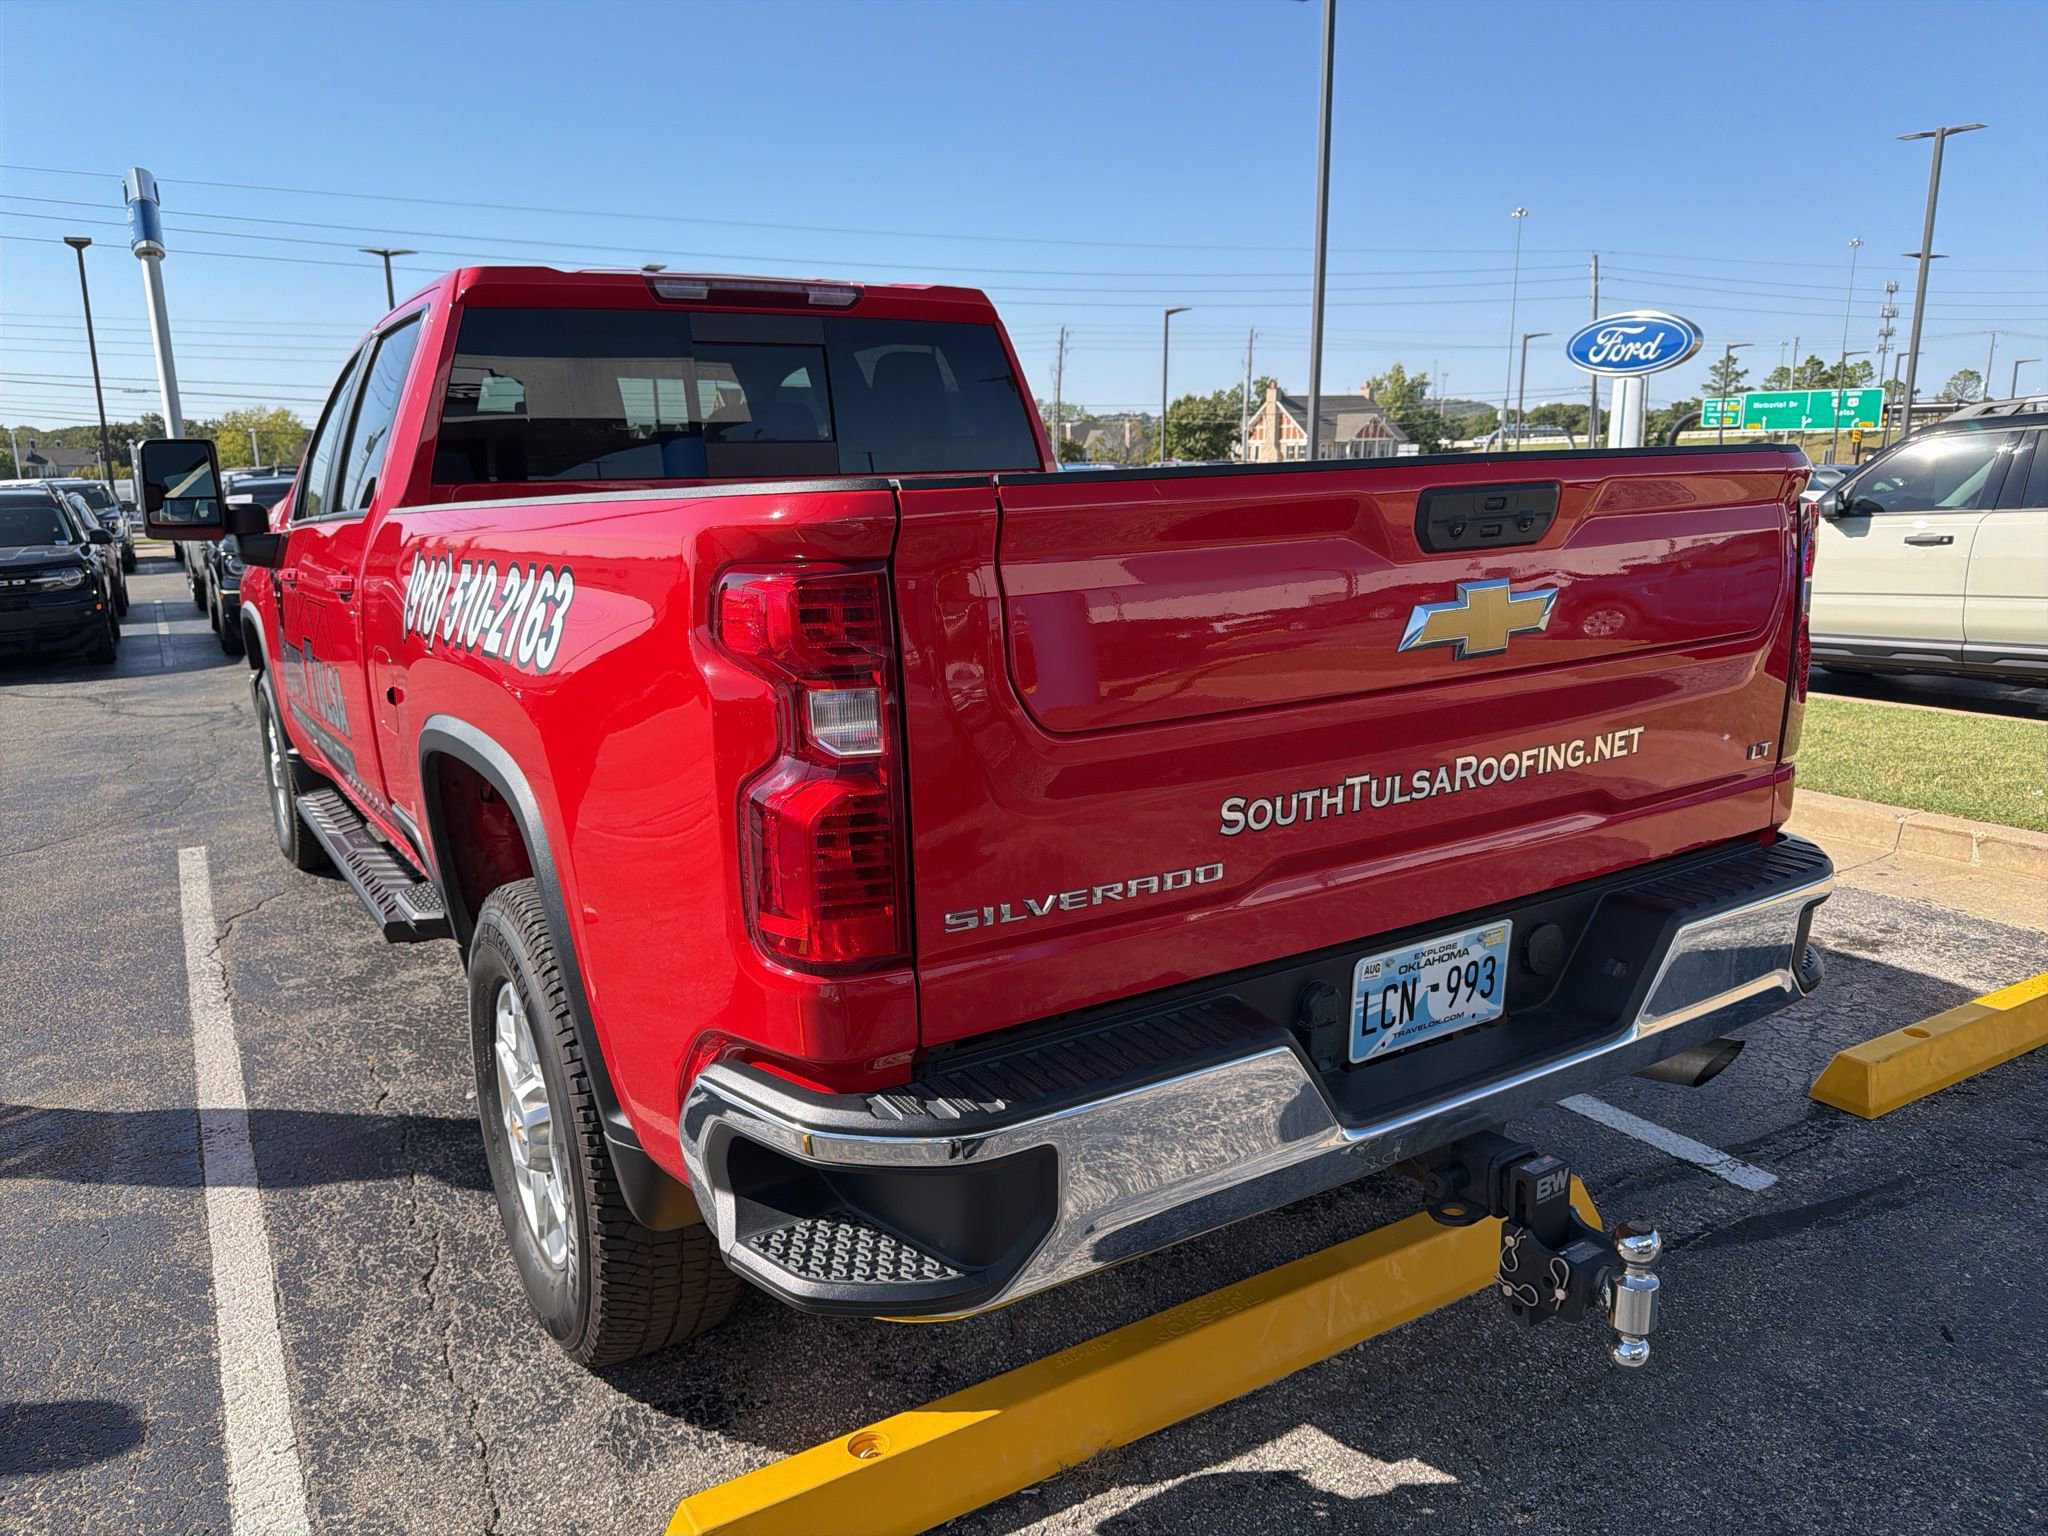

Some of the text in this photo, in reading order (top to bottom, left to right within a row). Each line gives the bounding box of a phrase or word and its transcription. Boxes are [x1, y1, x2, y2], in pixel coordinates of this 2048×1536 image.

[1588, 325, 1665, 363] Ford
[1747, 740, 1773, 760] LT
[944, 862, 1224, 934] SILVERADO
[1398, 947, 1470, 975] OKLAHOMA
[1414, 942, 1458, 960] EXPLORE
[1363, 962, 1381, 976] AUG
[1392, 1011, 1465, 1039] TRAVELOK.COM
